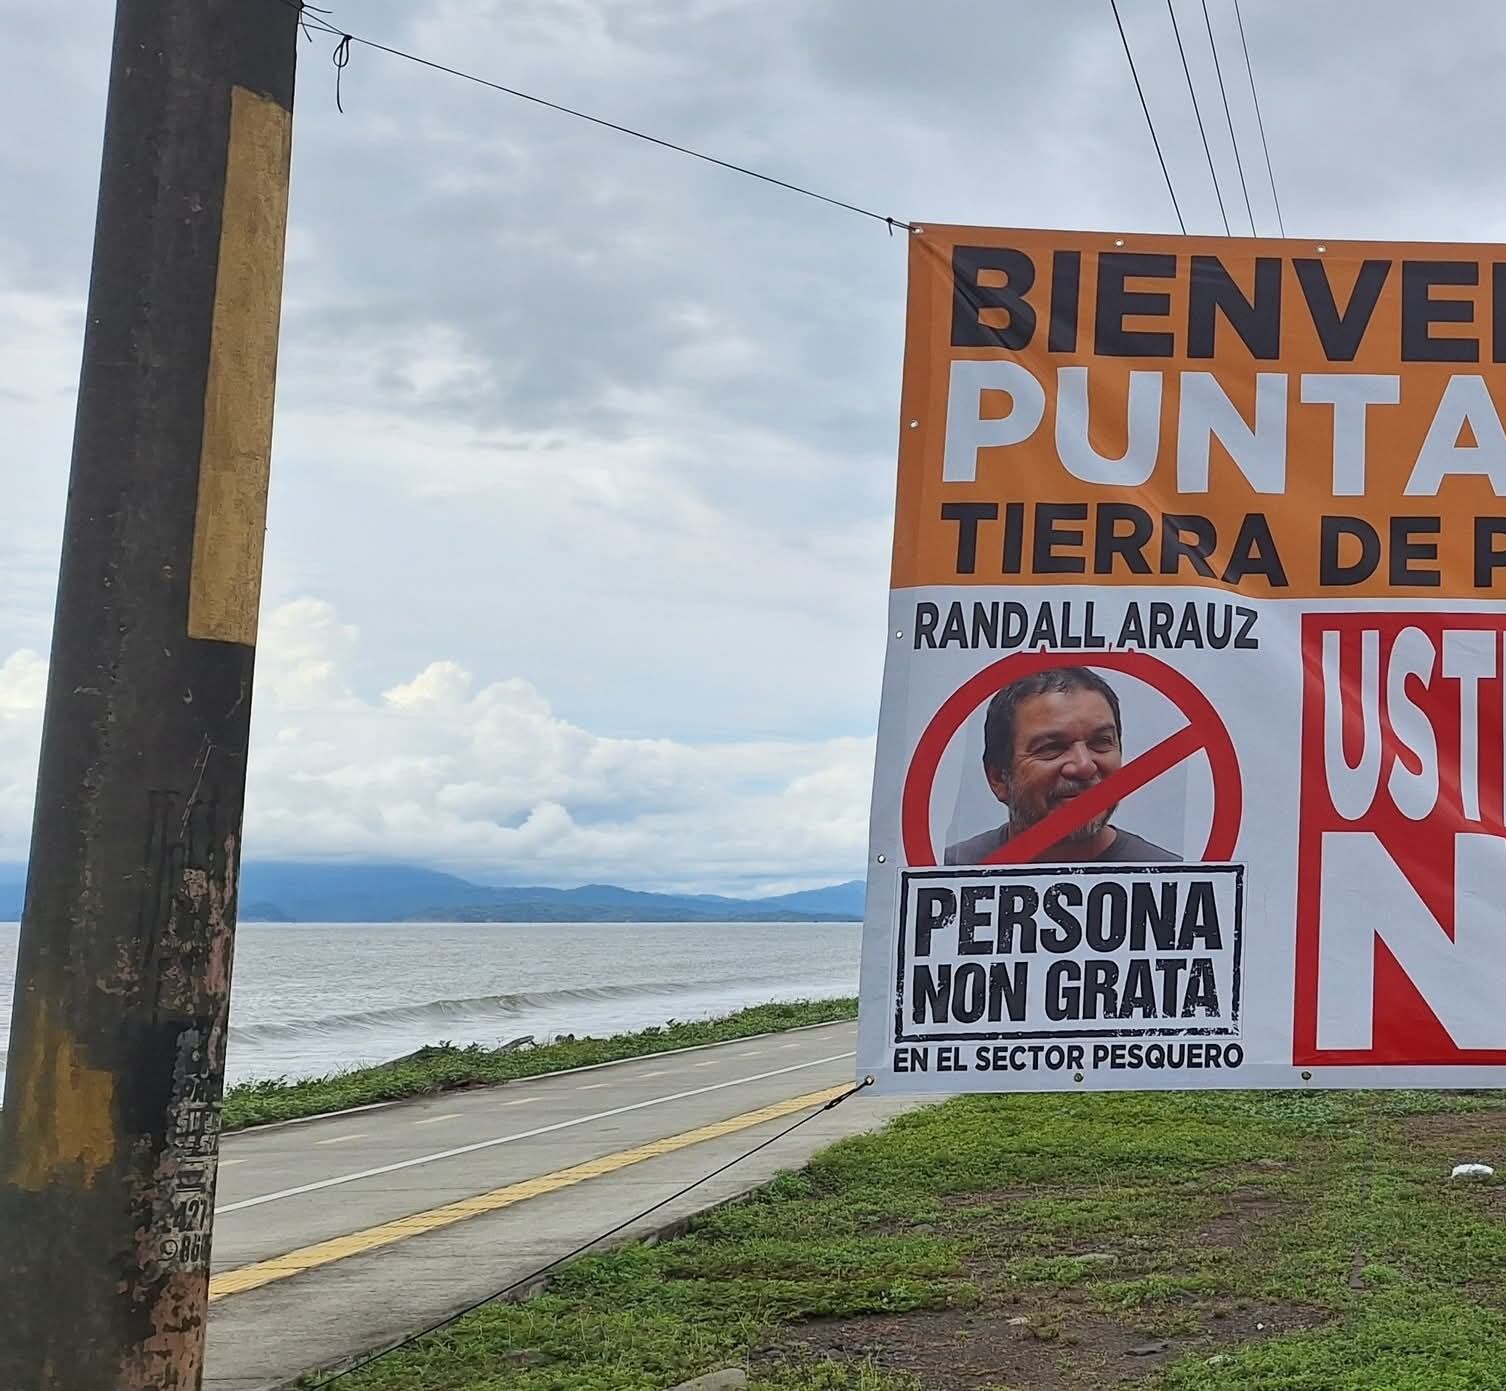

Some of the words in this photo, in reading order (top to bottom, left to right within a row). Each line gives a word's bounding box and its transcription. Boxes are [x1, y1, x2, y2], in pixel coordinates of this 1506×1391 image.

[940, 502, 1288, 588] TIERRA
[1318, 516, 1442, 588] DE
[914, 602, 1104, 649] RANDALL
[1116, 605, 1259, 650] ARAUZ
[914, 881, 1224, 958] PERSONA
[911, 961, 1029, 1025] NON
[1045, 957, 1222, 1022] GRATA
[892, 1046, 931, 1073] EN
[936, 1047, 969, 1073] EL
[975, 1045, 1085, 1072] SECTOR
[1092, 1043, 1244, 1071] PESQUERO
